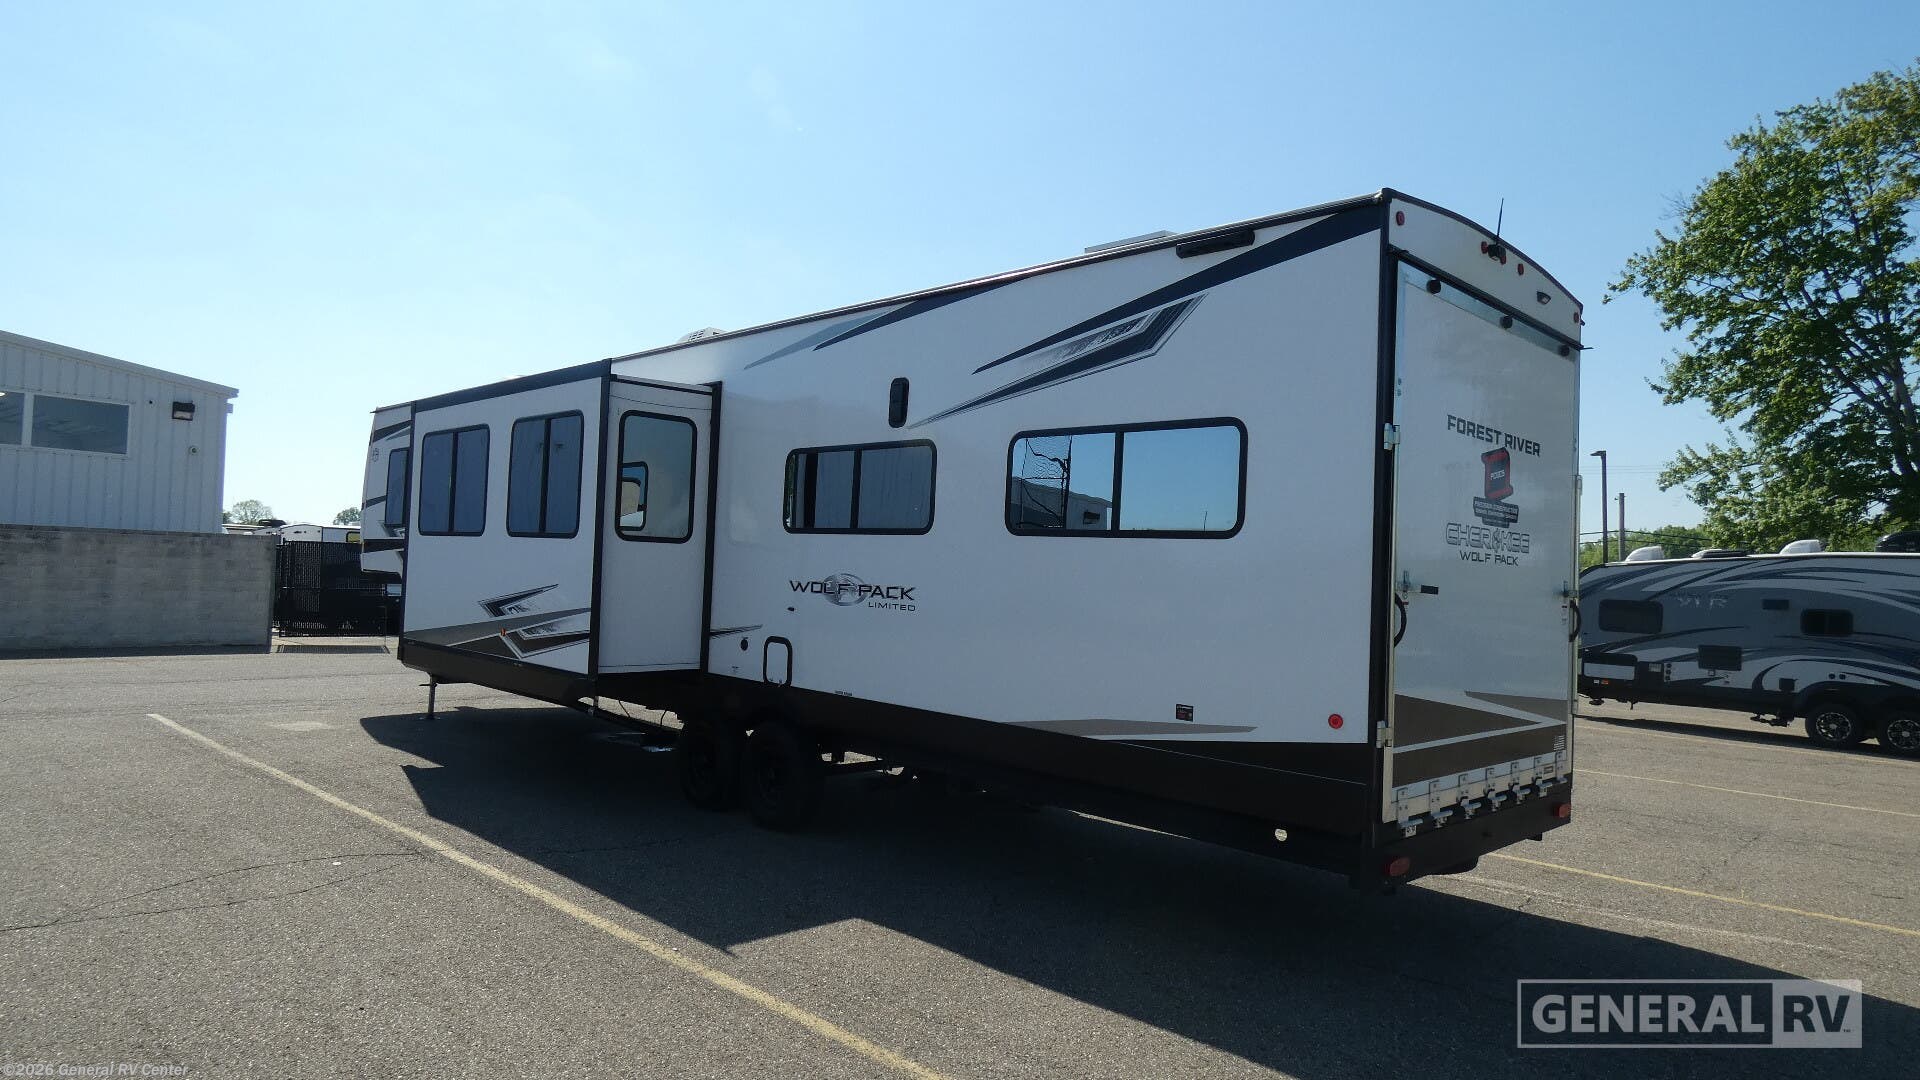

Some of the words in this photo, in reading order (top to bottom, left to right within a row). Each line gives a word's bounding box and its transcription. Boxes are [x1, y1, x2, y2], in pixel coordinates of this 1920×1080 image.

[1447, 414, 1501, 445] FOREST
[1504, 433, 1540, 457] RIVER
[1460, 550, 1491, 564] WOLF
[1495, 554, 1519, 566] PACK
[789, 580, 851, 595] WOLF
[858, 584, 916, 601] PACK
[868, 601, 916, 612] LIMITED
